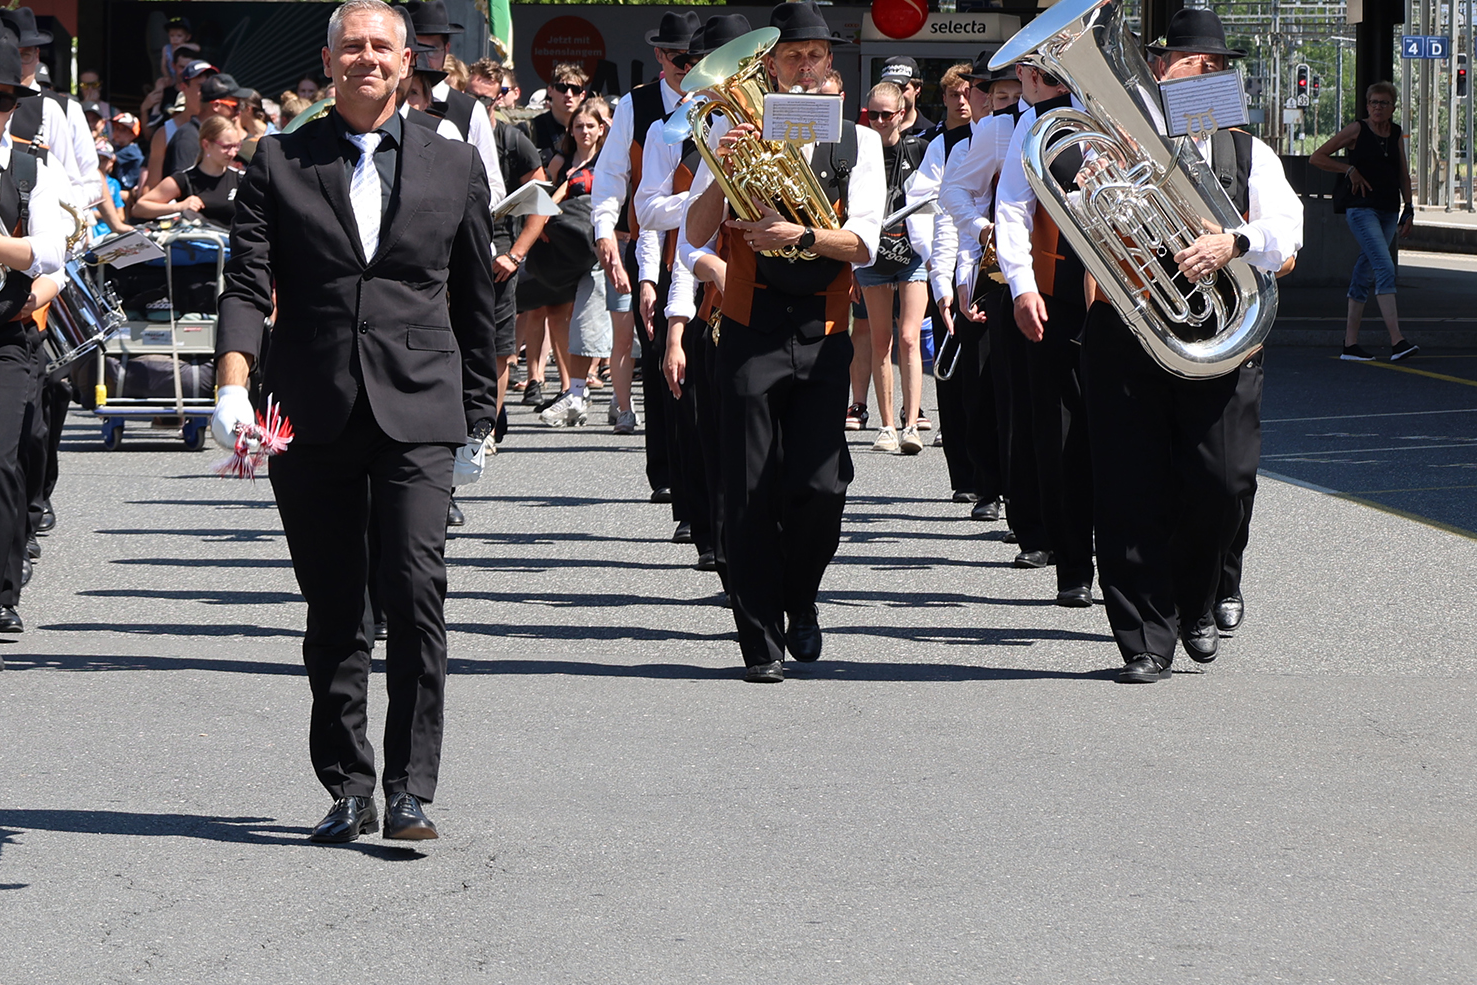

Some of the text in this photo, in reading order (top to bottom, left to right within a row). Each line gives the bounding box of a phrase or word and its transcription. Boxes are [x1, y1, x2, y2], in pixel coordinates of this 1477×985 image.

[930, 20, 987, 34] selecta
[547, 35, 590, 44] Jetzt mit
[534, 47, 603, 57] lebenslangem
[1408, 42, 1443, 55] 4 D
[878, 245, 911, 265] argans
